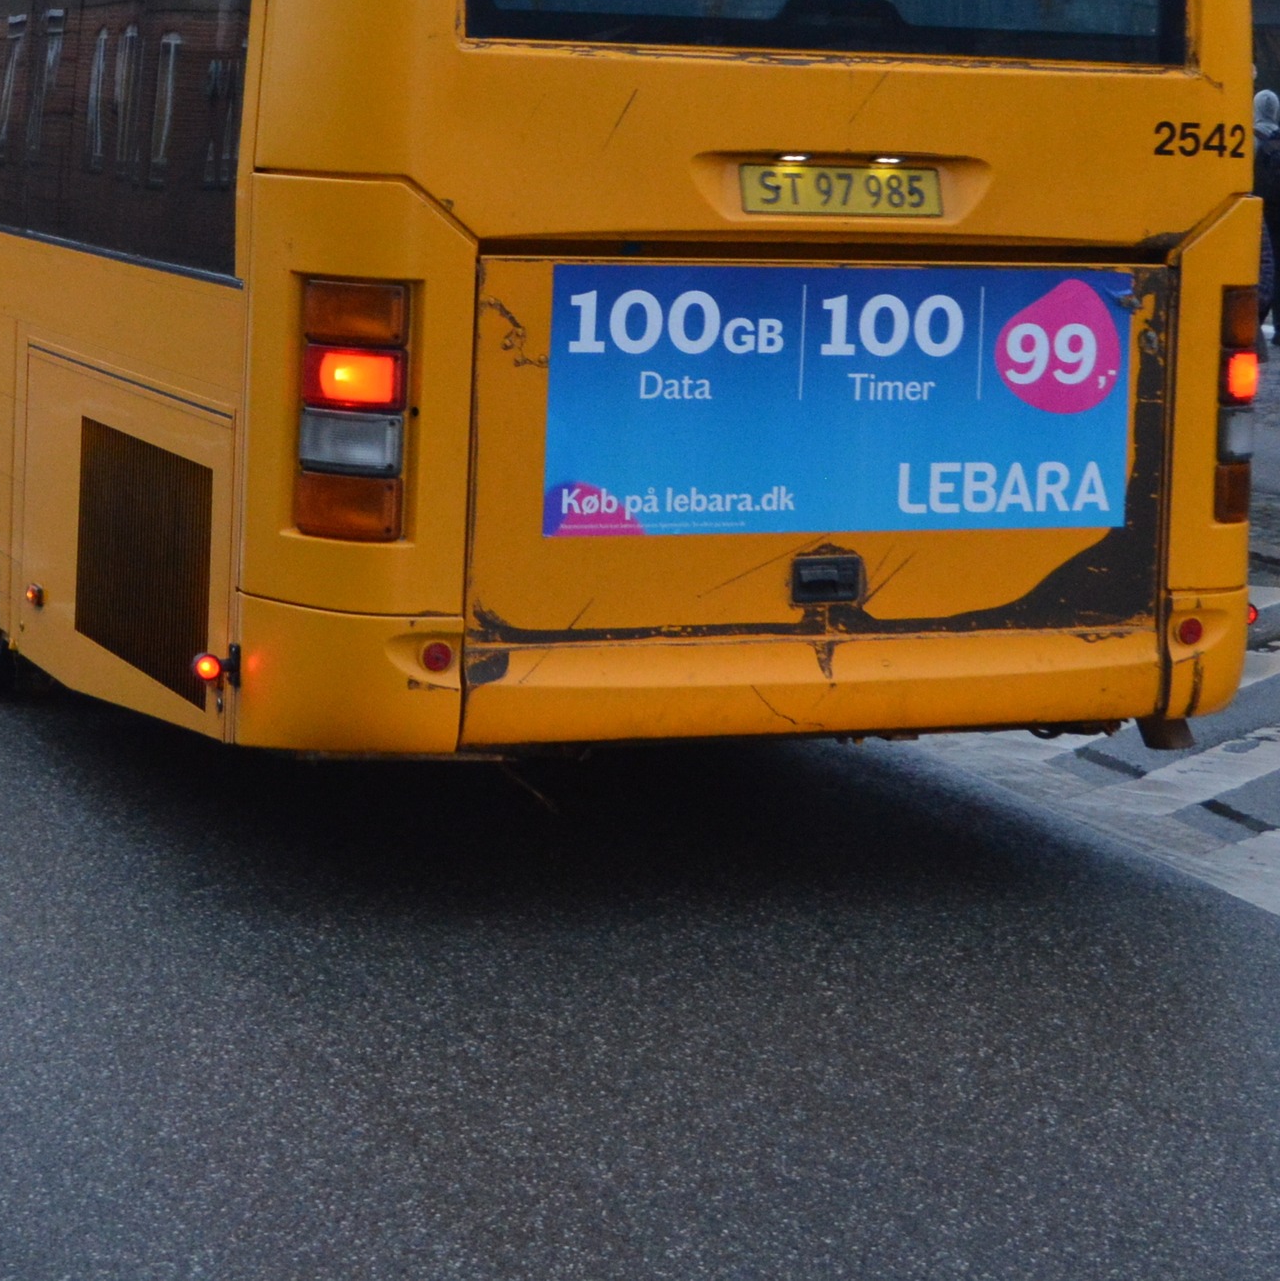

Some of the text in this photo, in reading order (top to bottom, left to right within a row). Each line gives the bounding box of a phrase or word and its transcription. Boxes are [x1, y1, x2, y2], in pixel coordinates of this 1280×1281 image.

[1154, 121, 1245, 158] 2542
[759, 171, 926, 209] ST 97 985
[820, 293, 964, 357] 100
[639, 371, 713, 400] Data
[847, 373, 936, 401] Timer
[561, 485, 796, 521] Køb på lebara.dk
[897, 460, 1111, 514] LEBARA
